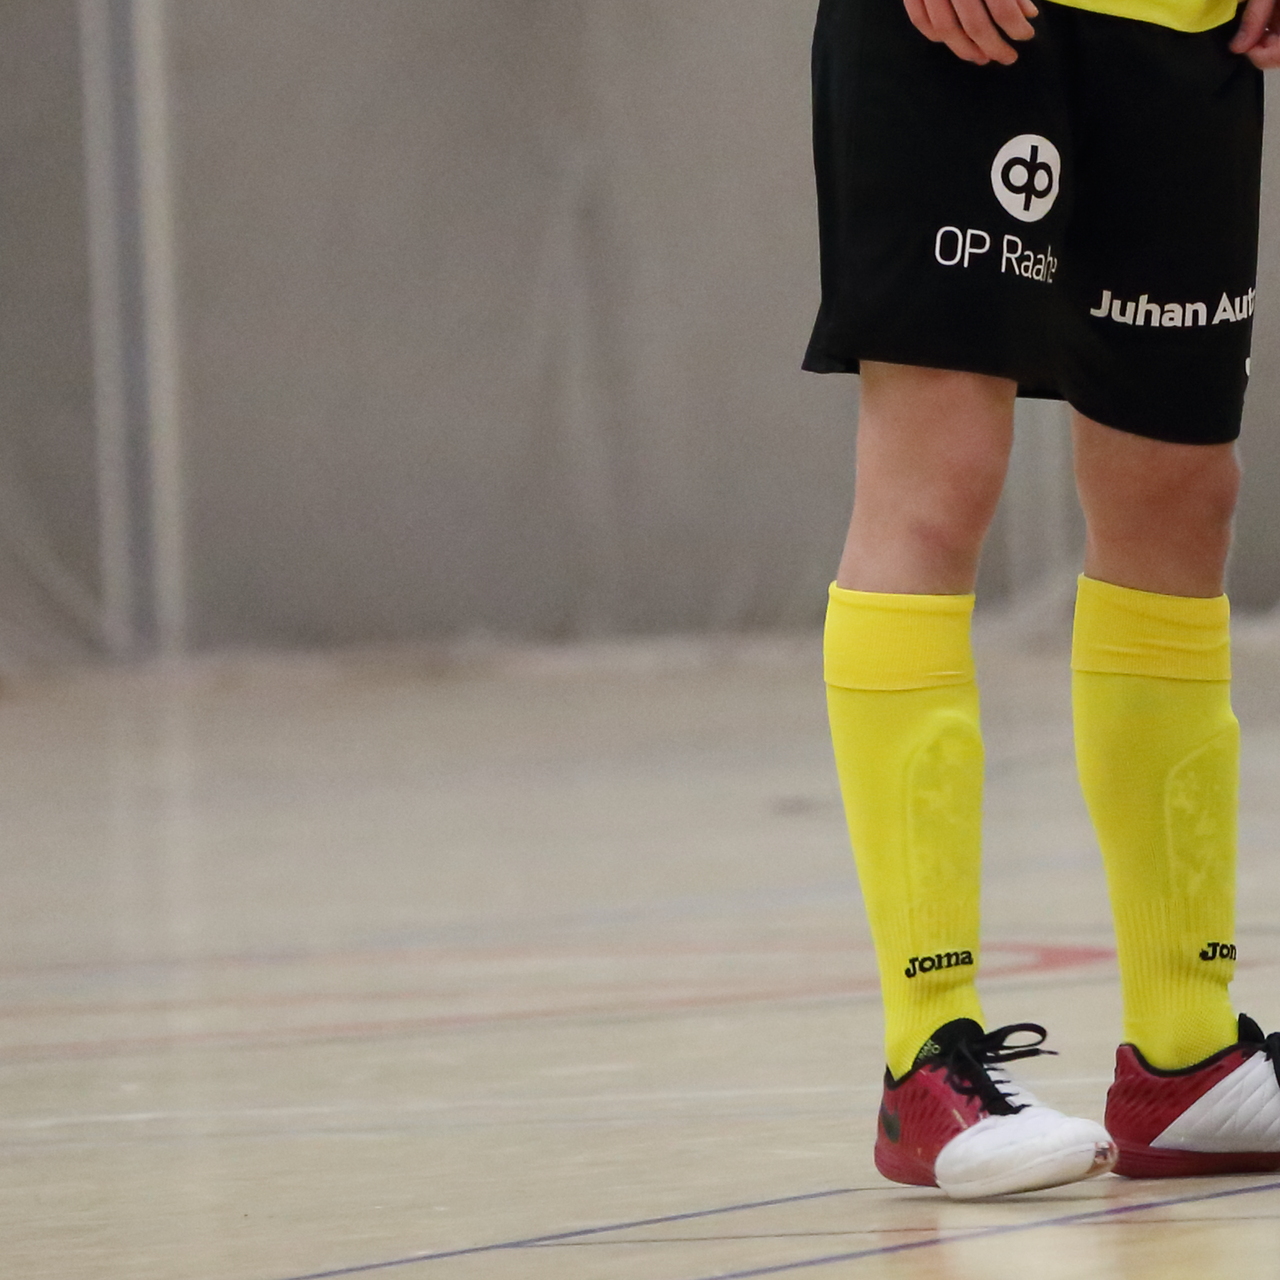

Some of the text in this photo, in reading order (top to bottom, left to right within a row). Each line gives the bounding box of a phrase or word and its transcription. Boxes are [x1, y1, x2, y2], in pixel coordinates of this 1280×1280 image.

[934, 225, 990, 268] OP
[1089, 287, 1255, 327] Juhan Aut
[904, 948, 974, 979] Joma
